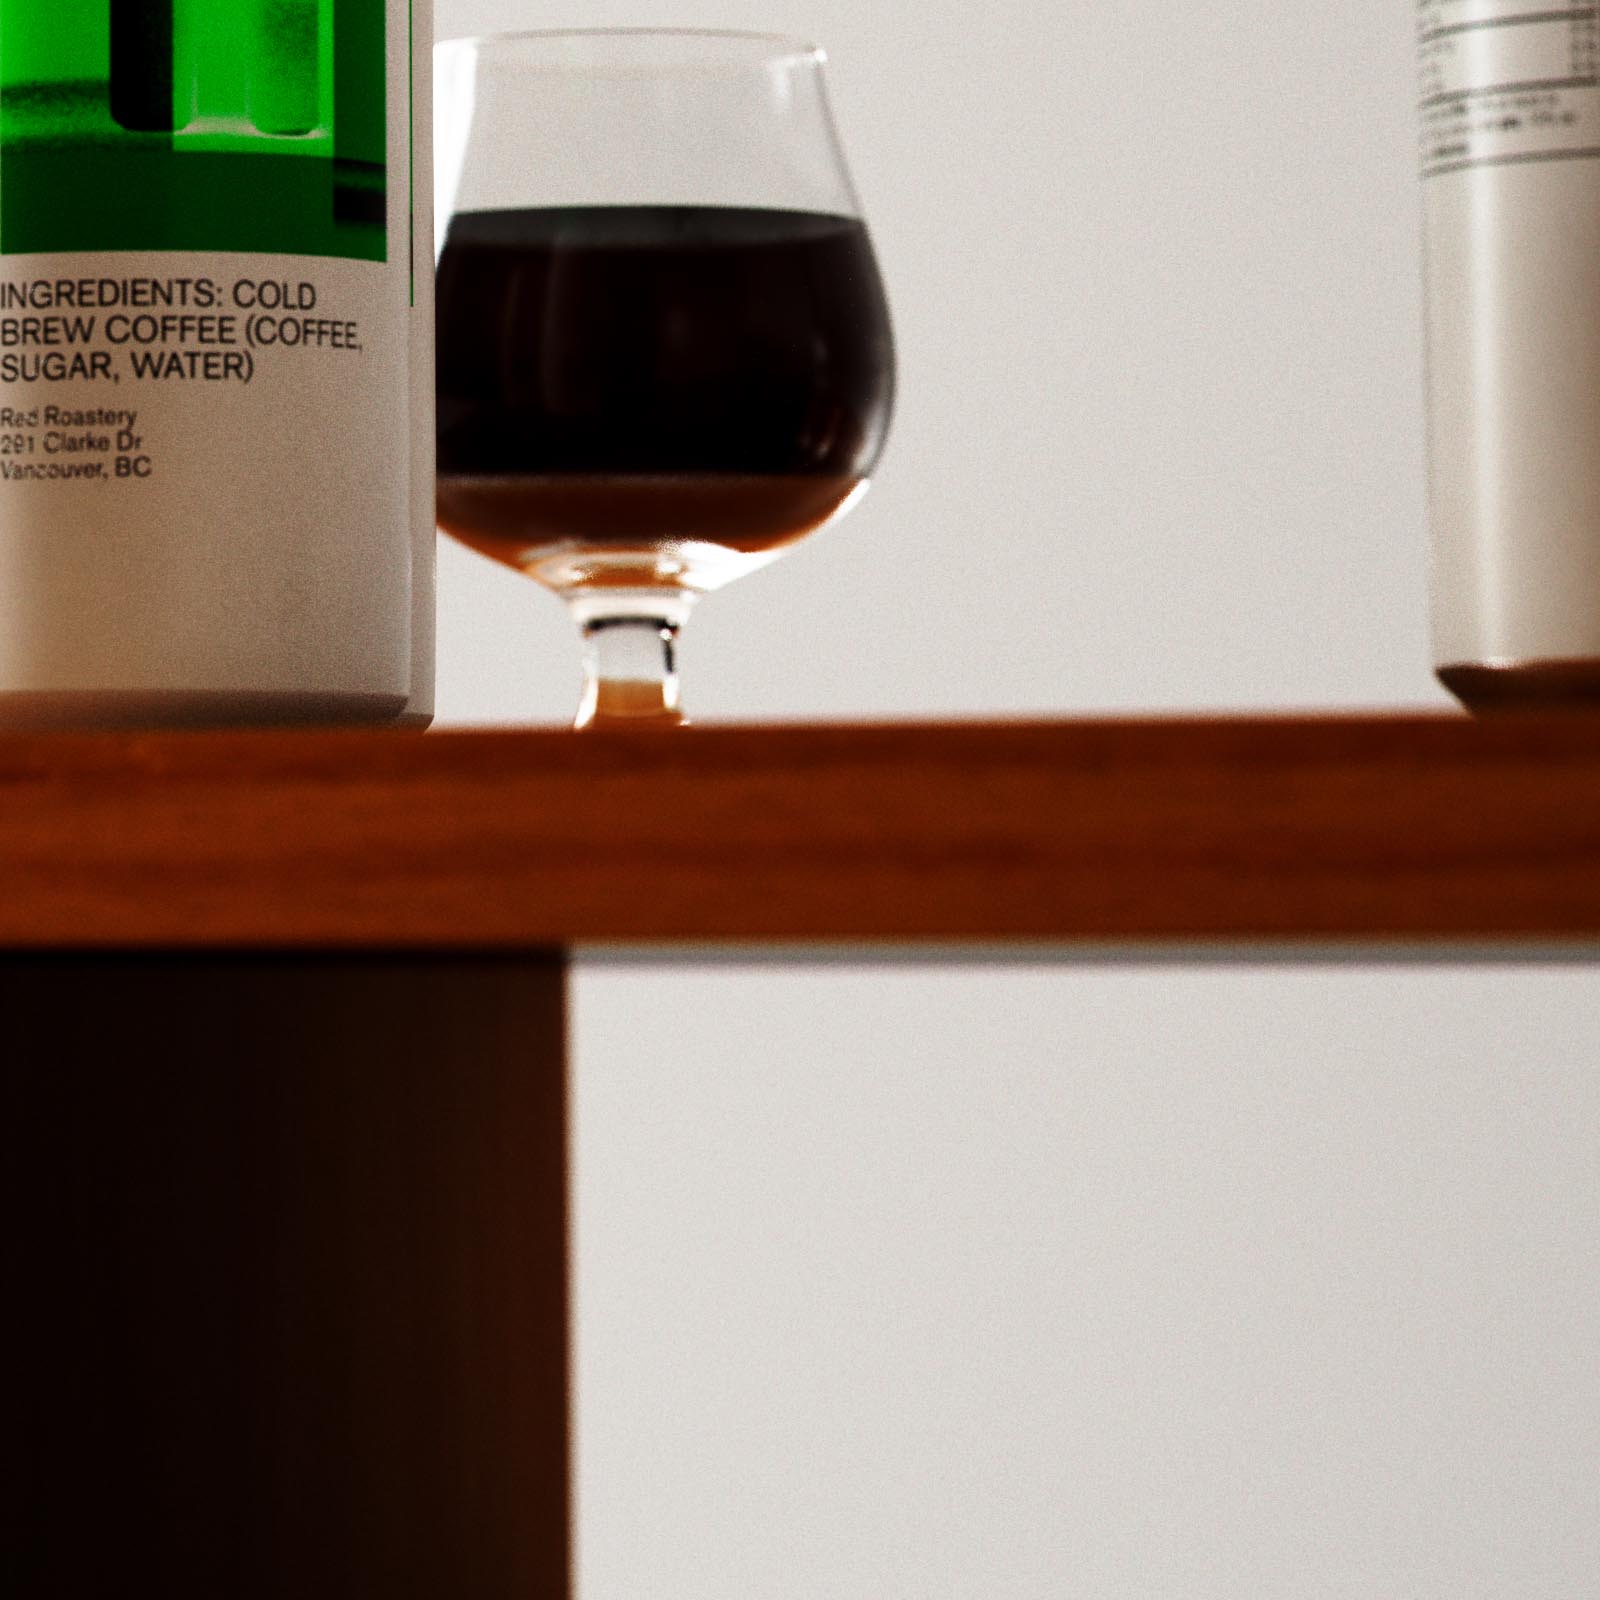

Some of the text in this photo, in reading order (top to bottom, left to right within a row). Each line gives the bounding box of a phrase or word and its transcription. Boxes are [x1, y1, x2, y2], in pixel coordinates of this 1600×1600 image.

[0, 278, 317, 311] INGREDIENTS: COLD
[0, 314, 363, 353] BREW COFFEE (COFFEE,
[0, 350, 255, 384] SUGAR, WATER)
[0, 405, 137, 431] Red Roastery
[43, 431, 111, 454] Clarke
[117, 430, 143, 452] Dr
[0, 455, 153, 482] Vancouver, BC
